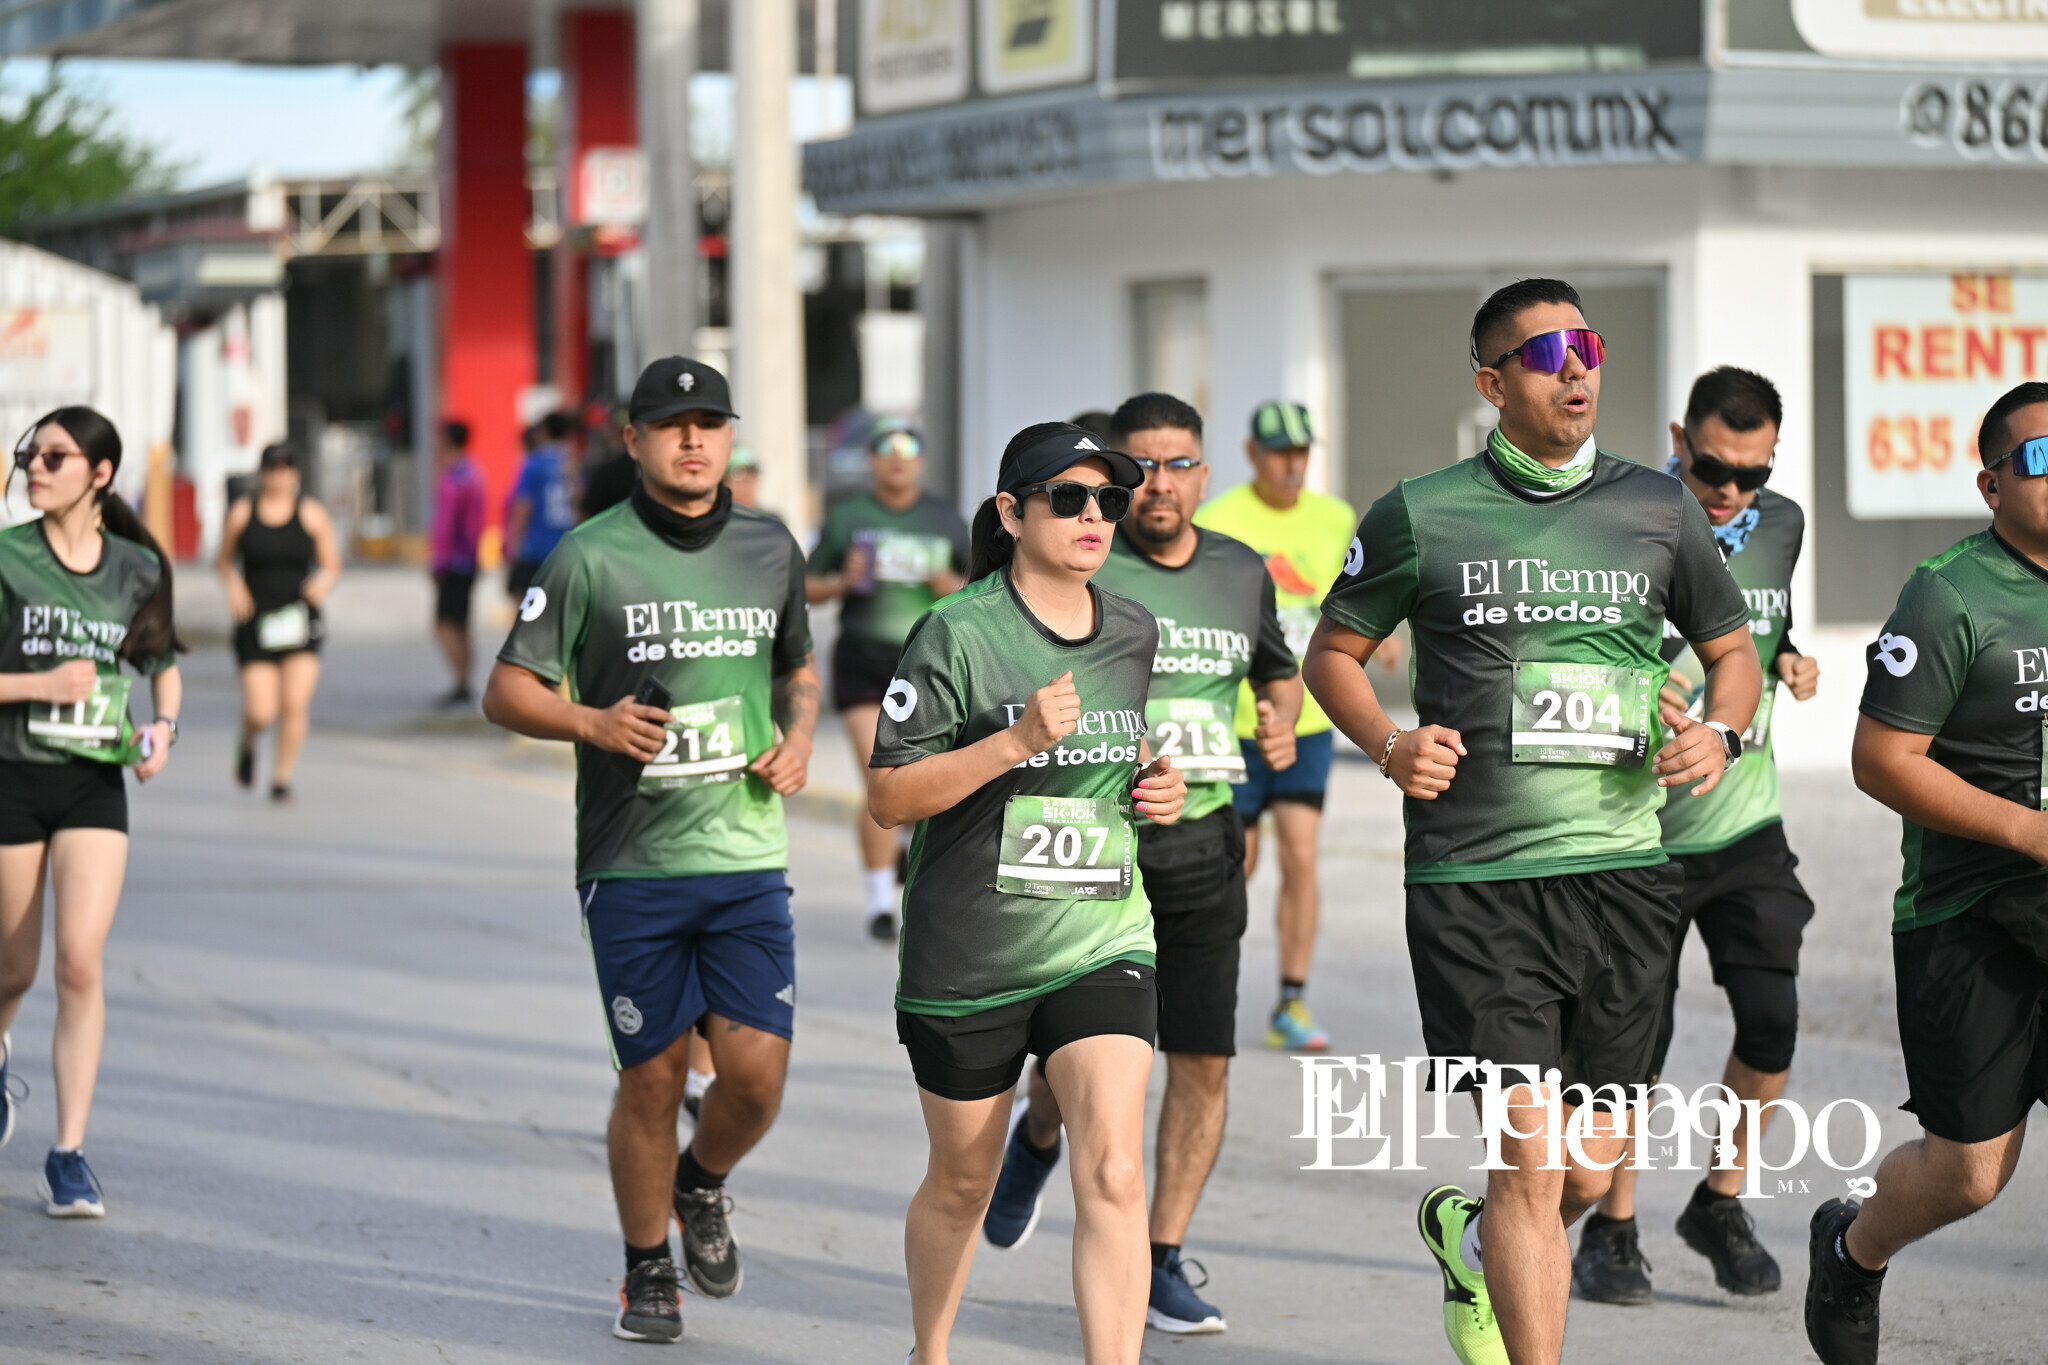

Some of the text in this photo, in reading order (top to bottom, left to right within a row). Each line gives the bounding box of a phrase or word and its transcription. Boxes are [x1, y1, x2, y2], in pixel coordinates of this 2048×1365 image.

[1952, 273, 2014, 314] SE
[1874, 322, 2048, 380] RENT
[1868, 413, 1953, 471] 635
[1458, 559, 1503, 597] El
[1508, 559, 1650, 603] Tiempo
[23, 606, 50, 634] El
[622, 600, 777, 638] El Tiempo
[1463, 600, 1622, 626] de todos
[22, 636, 53, 656] de
[627, 635, 757, 663] de todos
[1155, 617, 1250, 658] Tiempo
[1151, 653, 1233, 676] todos
[1550, 665, 1607, 675] CARRERA
[1532, 690, 1622, 732] 204
[1637, 693, 1648, 757] MEDALLA
[653, 722, 734, 764] 214
[1013, 742, 1137, 769] e todos
[1156, 721, 1233, 756] 213
[1042, 799, 1097, 808] CARRERA
[1018, 824, 1110, 867] 207
[1123, 820, 1131, 886] MEDALLA
